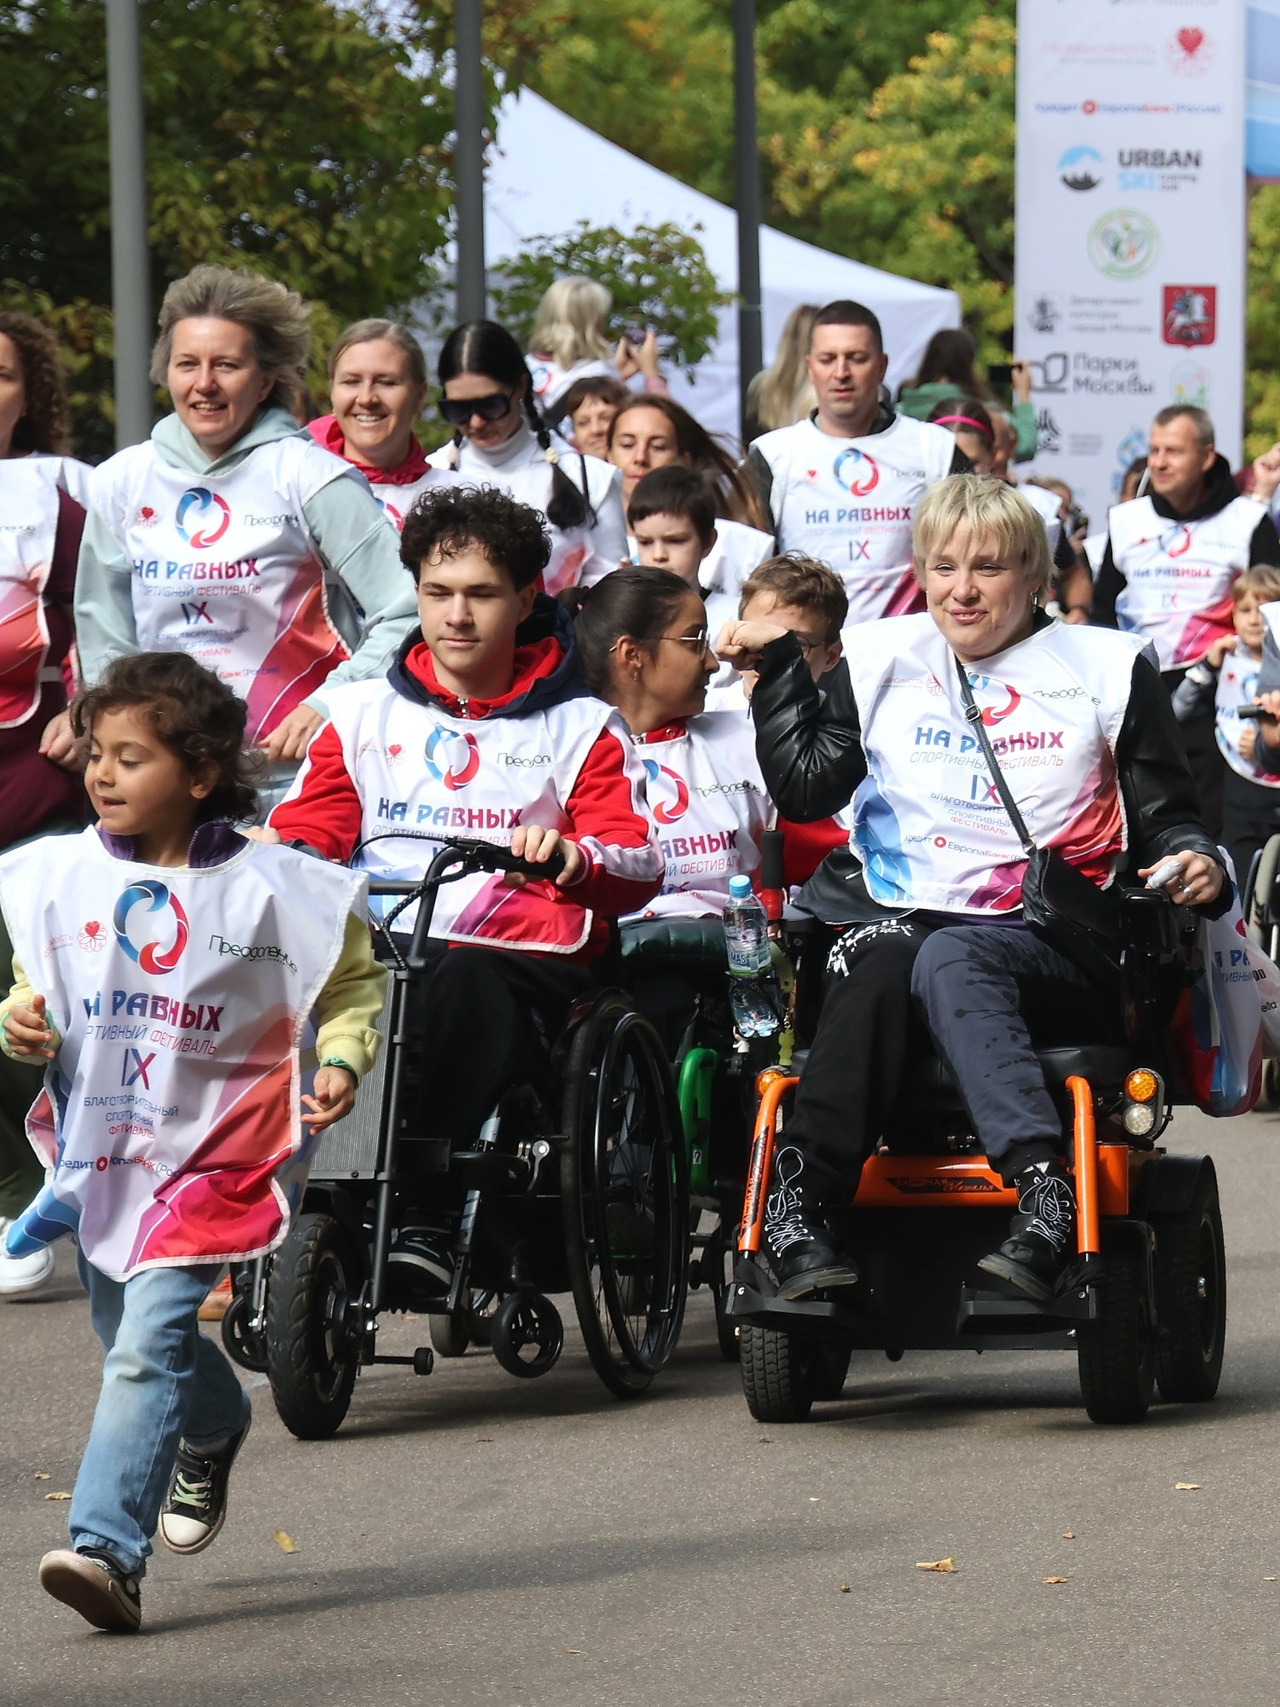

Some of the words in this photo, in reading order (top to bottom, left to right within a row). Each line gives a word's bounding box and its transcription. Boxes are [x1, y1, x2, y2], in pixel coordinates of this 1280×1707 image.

[1118, 148, 1201, 168] URBAN
[1073, 353, 1138, 372] Парки
[1073, 374, 1154, 394] Москвы
[805, 510, 829, 523] НА
[837, 507, 911, 521] РАВНЫХ
[849, 540, 870, 560] IX
[167, 558, 260, 580] РАВНЫХ
[197, 583, 262, 597] ФЕСТИВАЛЬ
[181, 601, 214, 625] IX
[914, 727, 951, 748] НА
[960, 731, 1064, 755] РВНЫХ
[970, 775, 1001, 805] IX
[378, 797, 407, 820] НА
[416, 804, 523, 829] РАВНЫХ
[951, 816, 1008, 836] ФЕСТИВАЛЬ
[663, 830, 738, 859] АВНЫХ
[948, 841, 1010, 860] ЕвропаБанк
[681, 856, 736, 875] ФЕСТИВА
[112, 990, 225, 1032] РАВНЫХ
[86, 1024, 148, 1041] РТИВНЫЙ
[121, 1048, 157, 1090] IX
[60, 1159, 95, 1170] редит
